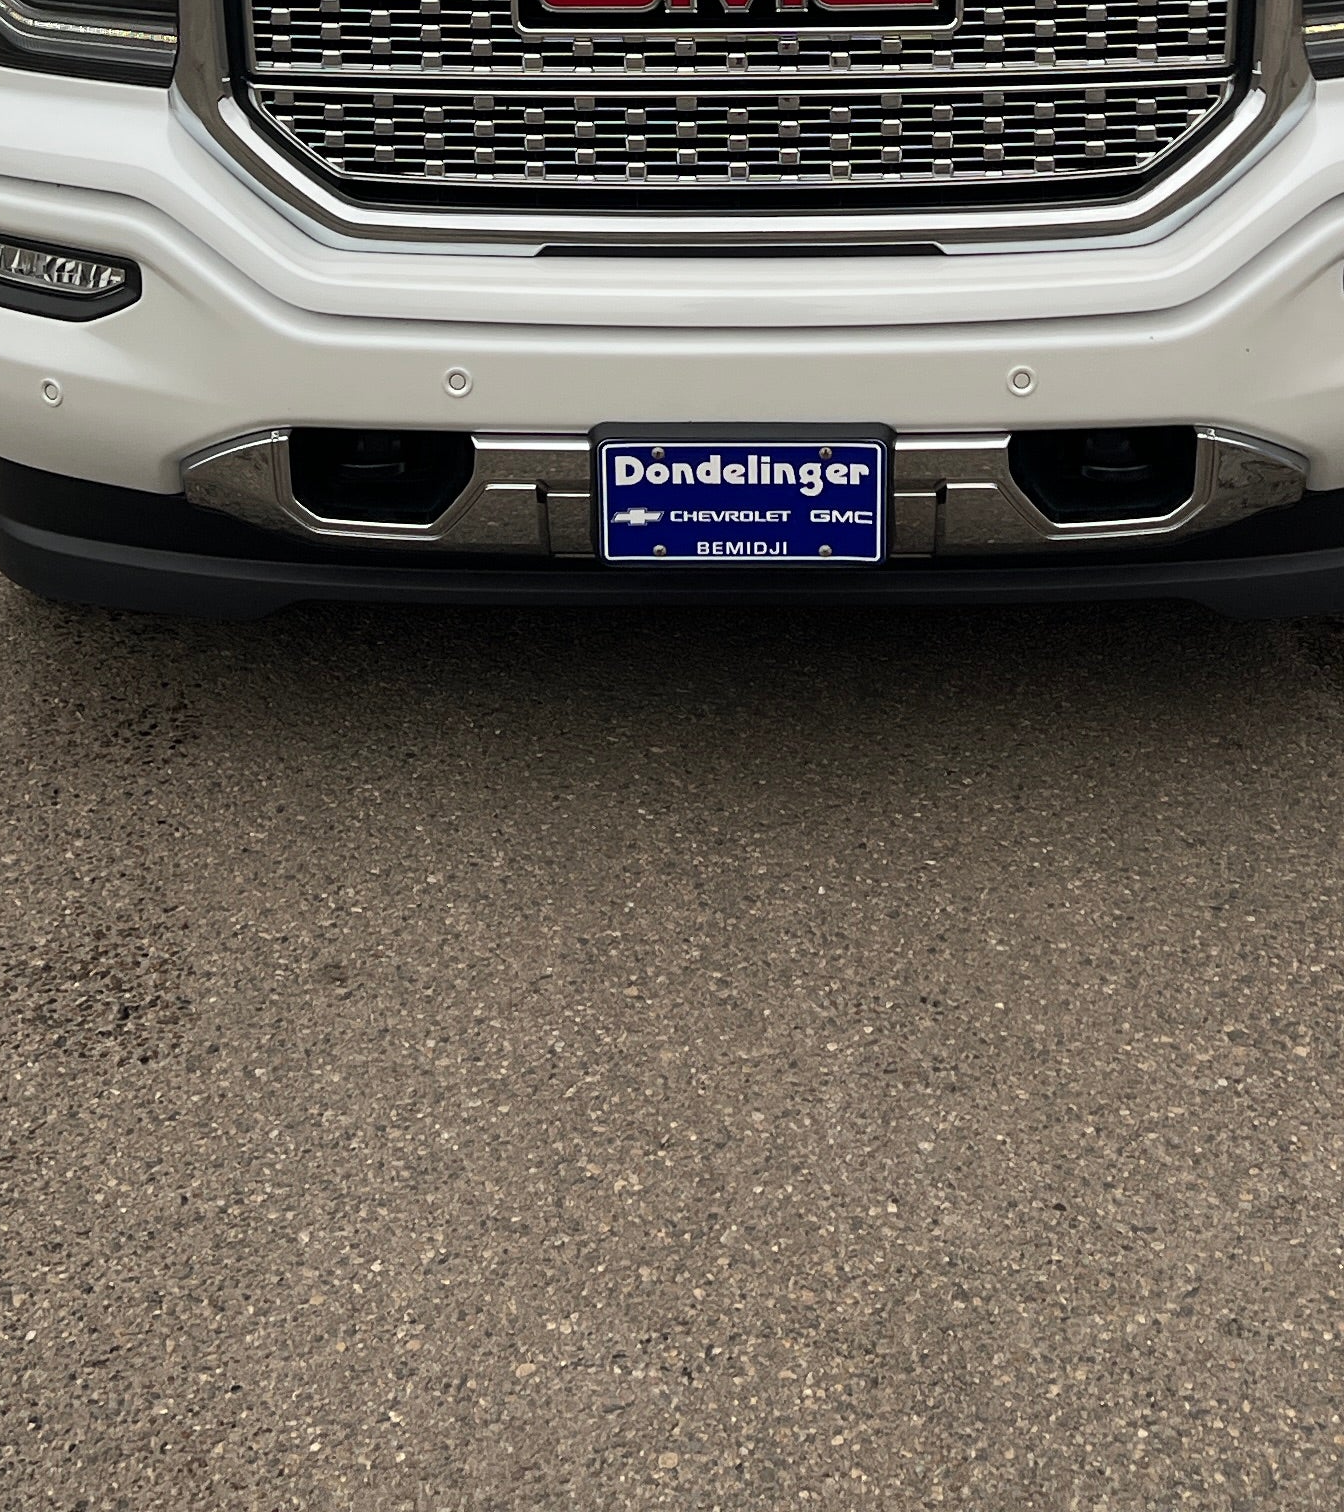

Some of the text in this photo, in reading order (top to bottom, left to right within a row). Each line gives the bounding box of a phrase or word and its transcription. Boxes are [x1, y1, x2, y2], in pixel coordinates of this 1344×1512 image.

[614, 454, 870, 496] Dondelinger
[669, 509, 873, 525] CHEVROLET GMC
[696, 541, 788, 555] BEMIDJI
